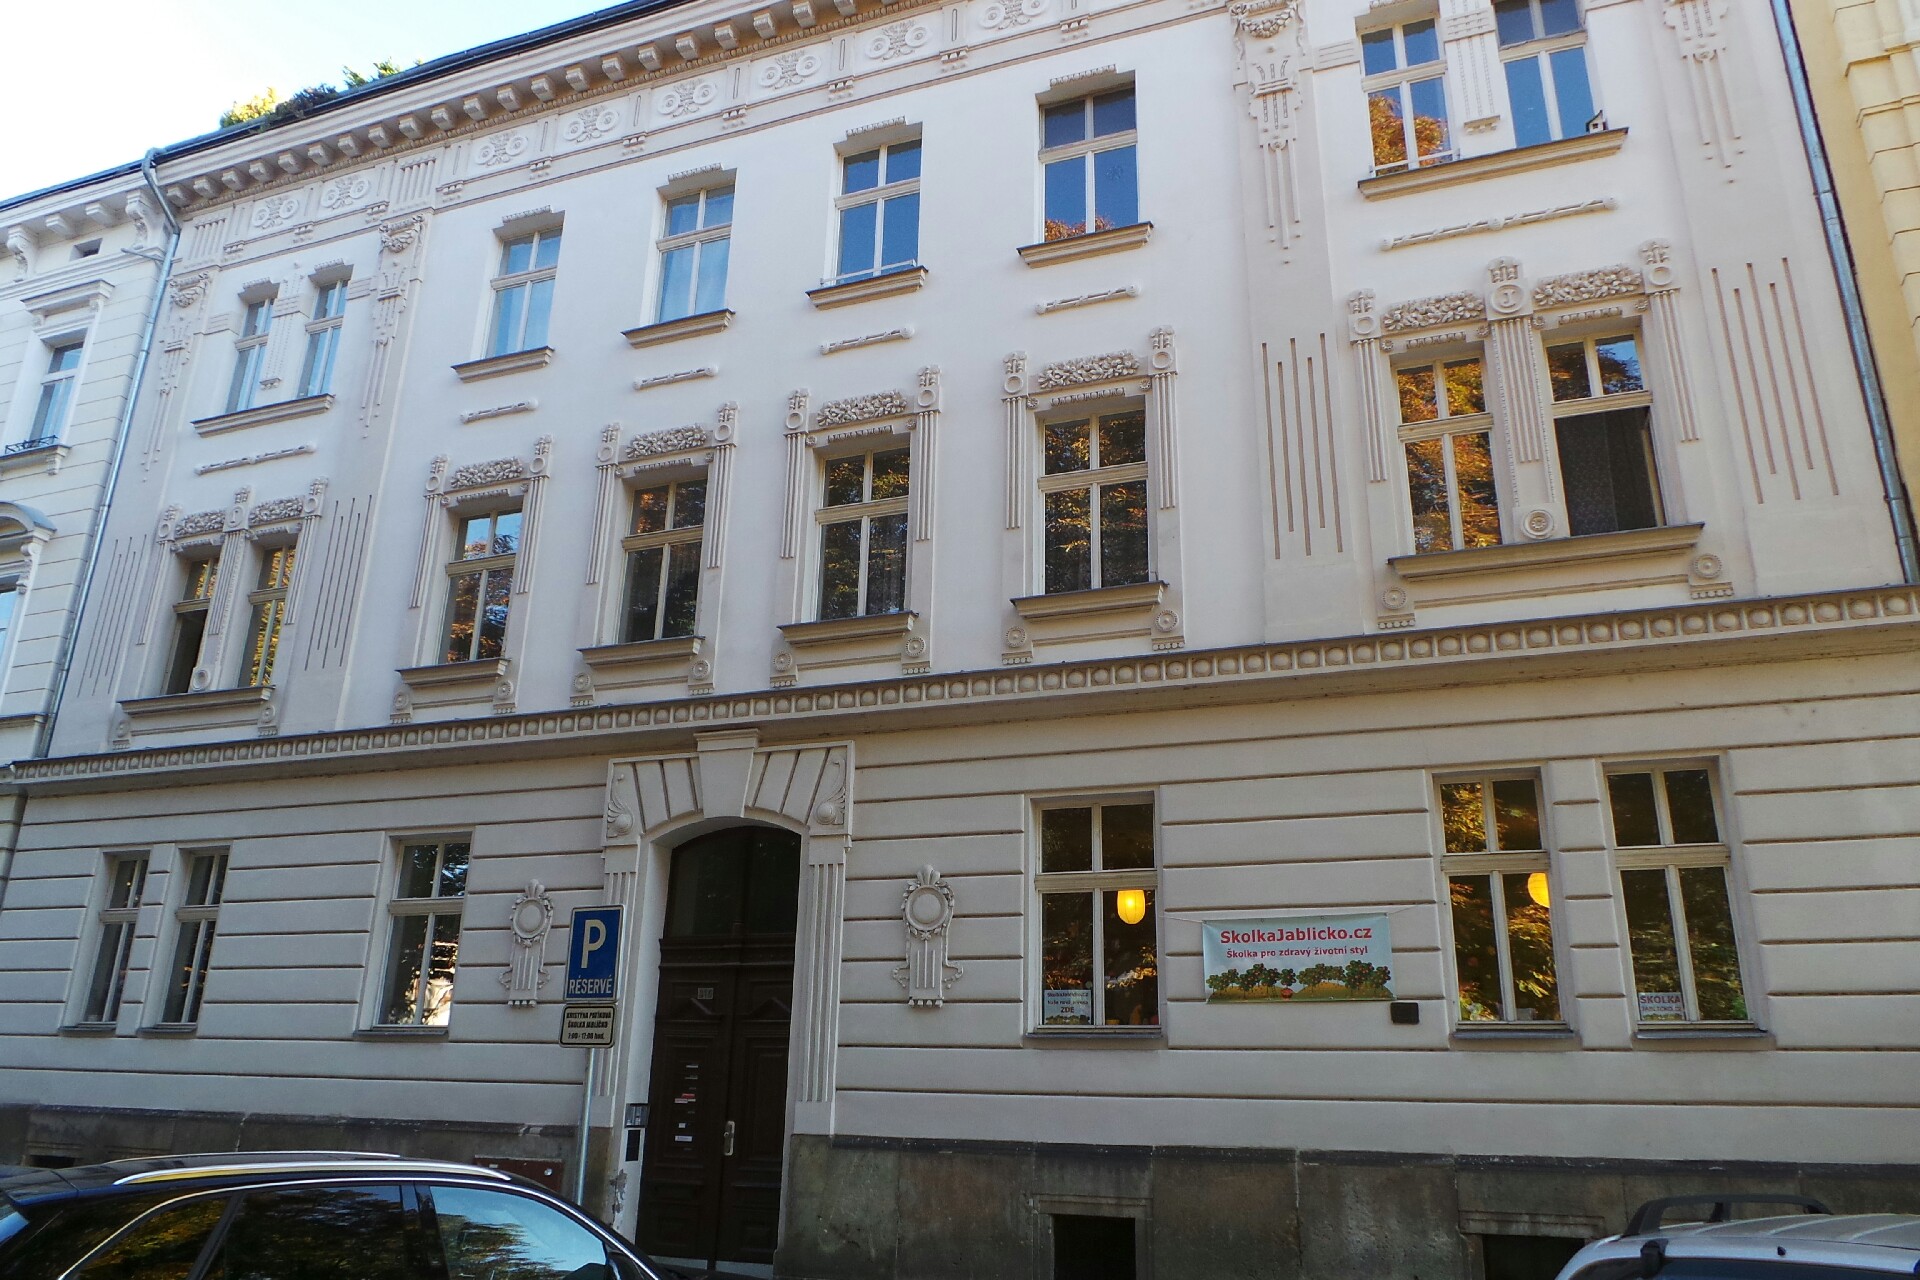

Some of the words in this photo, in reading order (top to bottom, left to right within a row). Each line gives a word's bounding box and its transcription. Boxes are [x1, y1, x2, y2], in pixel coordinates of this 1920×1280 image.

[581, 919, 607, 969] P
[1220, 926, 1373, 944] SkolkaJablicko.cz
[1226, 948, 1258, 959] Školka
[1260, 950, 1276, 959] pro
[1279, 947, 1311, 958] zdravý
[1314, 946, 1347, 957] životní
[1350, 945, 1368, 956] styl
[568, 974, 613, 994] RÉSERVÉ
